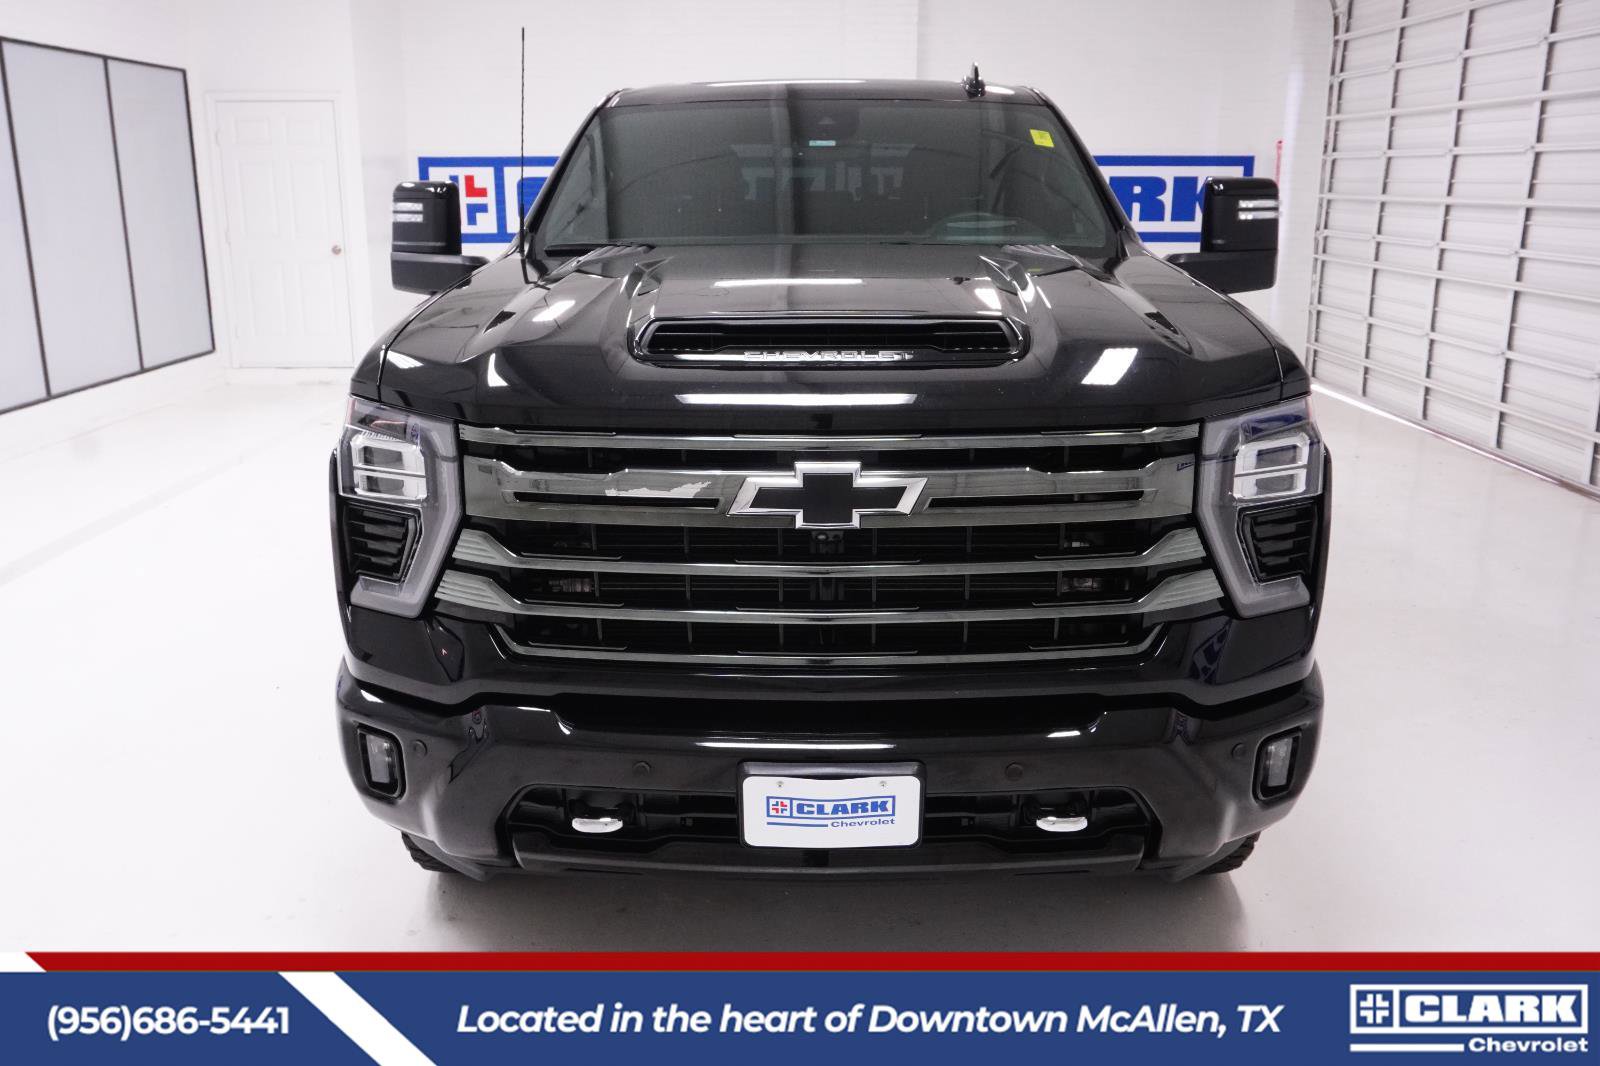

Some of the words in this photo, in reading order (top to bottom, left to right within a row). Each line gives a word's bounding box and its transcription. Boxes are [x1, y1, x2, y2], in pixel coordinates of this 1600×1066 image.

[743, 350, 914, 362] CHEVROLET
[796, 800, 889, 815] CLARK
[830, 818, 895, 828] Chevrolet
